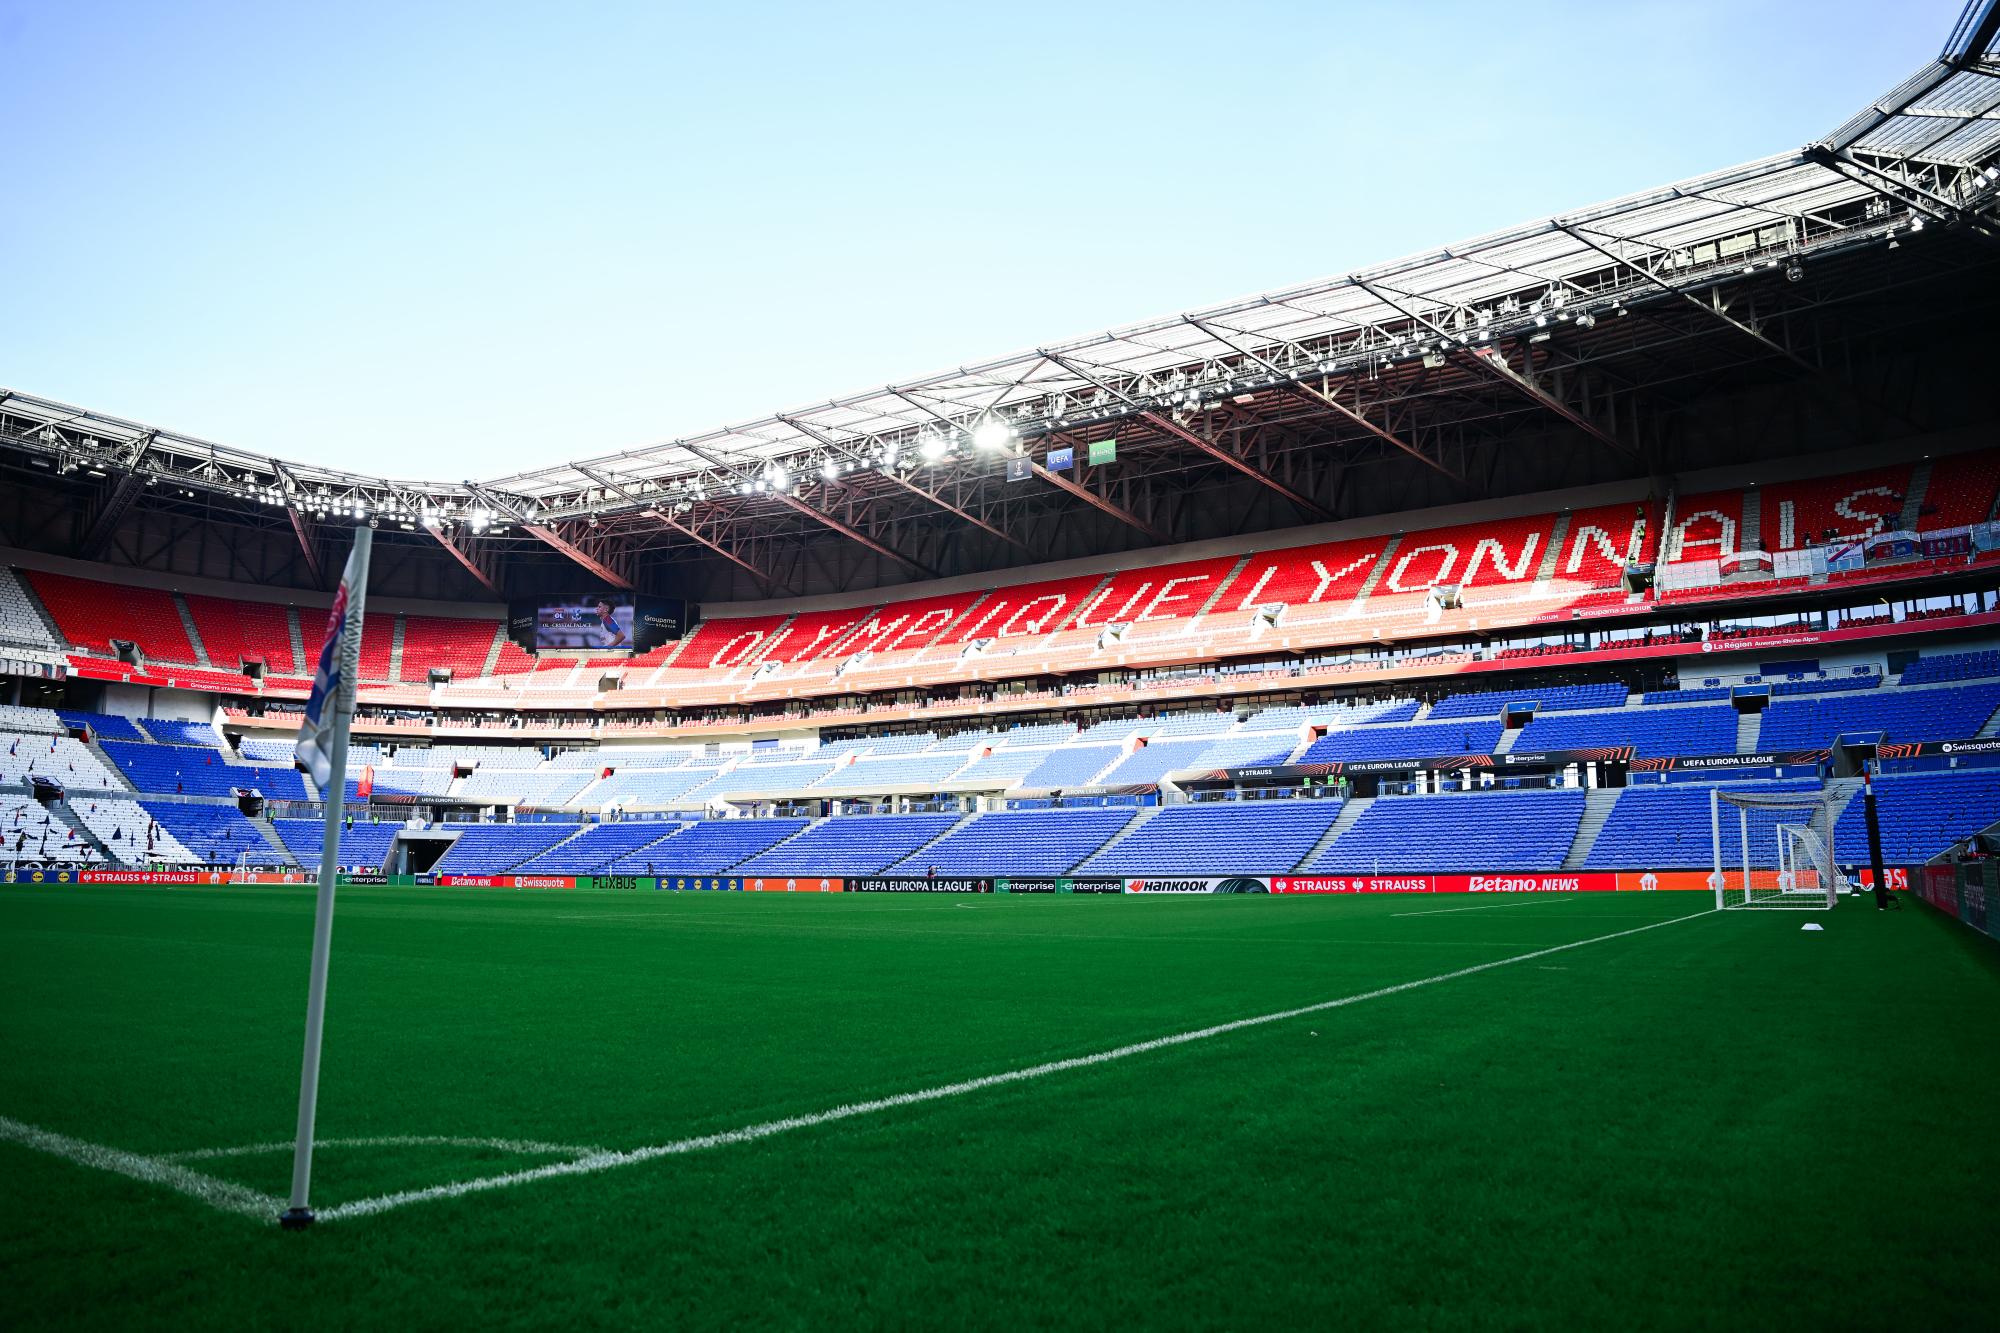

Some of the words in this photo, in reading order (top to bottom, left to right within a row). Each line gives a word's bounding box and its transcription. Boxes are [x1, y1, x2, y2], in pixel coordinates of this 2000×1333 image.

[1050, 455, 1069, 464] UEFA
[709, 574, 1210, 668] OLYMPIQUE
[1238, 486, 1901, 609] LYONNAIS
[1579, 608, 1619, 617] Groupama
[1724, 640, 1753, 650] Région
[190, 683, 220, 691] Groupama
[1952, 741, 2000, 751] Swissquote
[1394, 761, 1420, 769] LEAGUE
[1683, 759, 1705, 767] UEFA
[1706, 757, 1739, 766] EUROPA
[1741, 755, 1774, 764] LEAGUE
[94, 873, 140, 882] STRAUSS
[152, 874, 195, 882] STRAUSS
[344, 875, 388, 884] enterprise
[523, 877, 565, 889] Swissquote
[861, 880, 887, 891] UEFA
[889, 880, 929, 892] EUROPA
[931, 880, 972, 892] LEAGUE
[1001, 881, 1055, 892] enterprise
[1064, 881, 1121, 892] enterprise
[1292, 880, 1346, 891] STRAUSS
[1369, 879, 1426, 890] STRAUSS
[1468, 876, 1579, 892] Betano.NEWS
